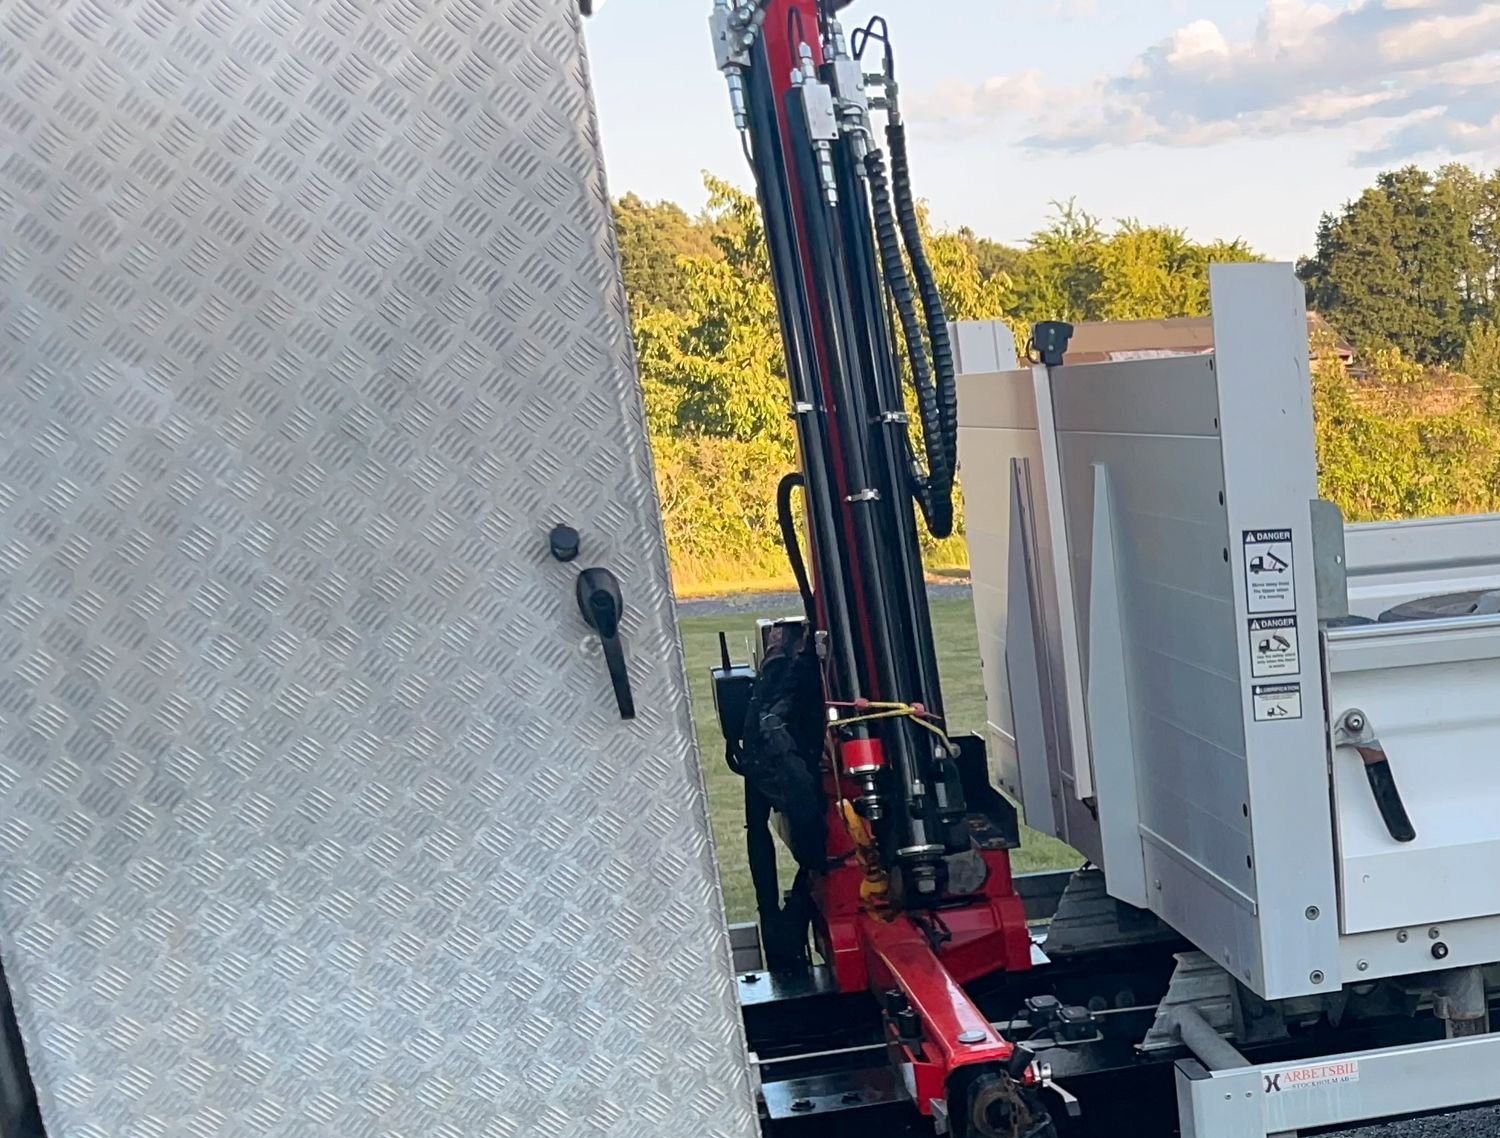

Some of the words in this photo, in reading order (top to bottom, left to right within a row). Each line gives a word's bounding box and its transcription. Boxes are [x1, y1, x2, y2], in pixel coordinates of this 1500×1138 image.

[1256, 531, 1290, 541] DANGER
[1261, 618, 1294, 628] DANGER
[1284, 1063, 1357, 1082] ARBETSBIL
[1292, 1077, 1338, 1088] STOCKHOLM
